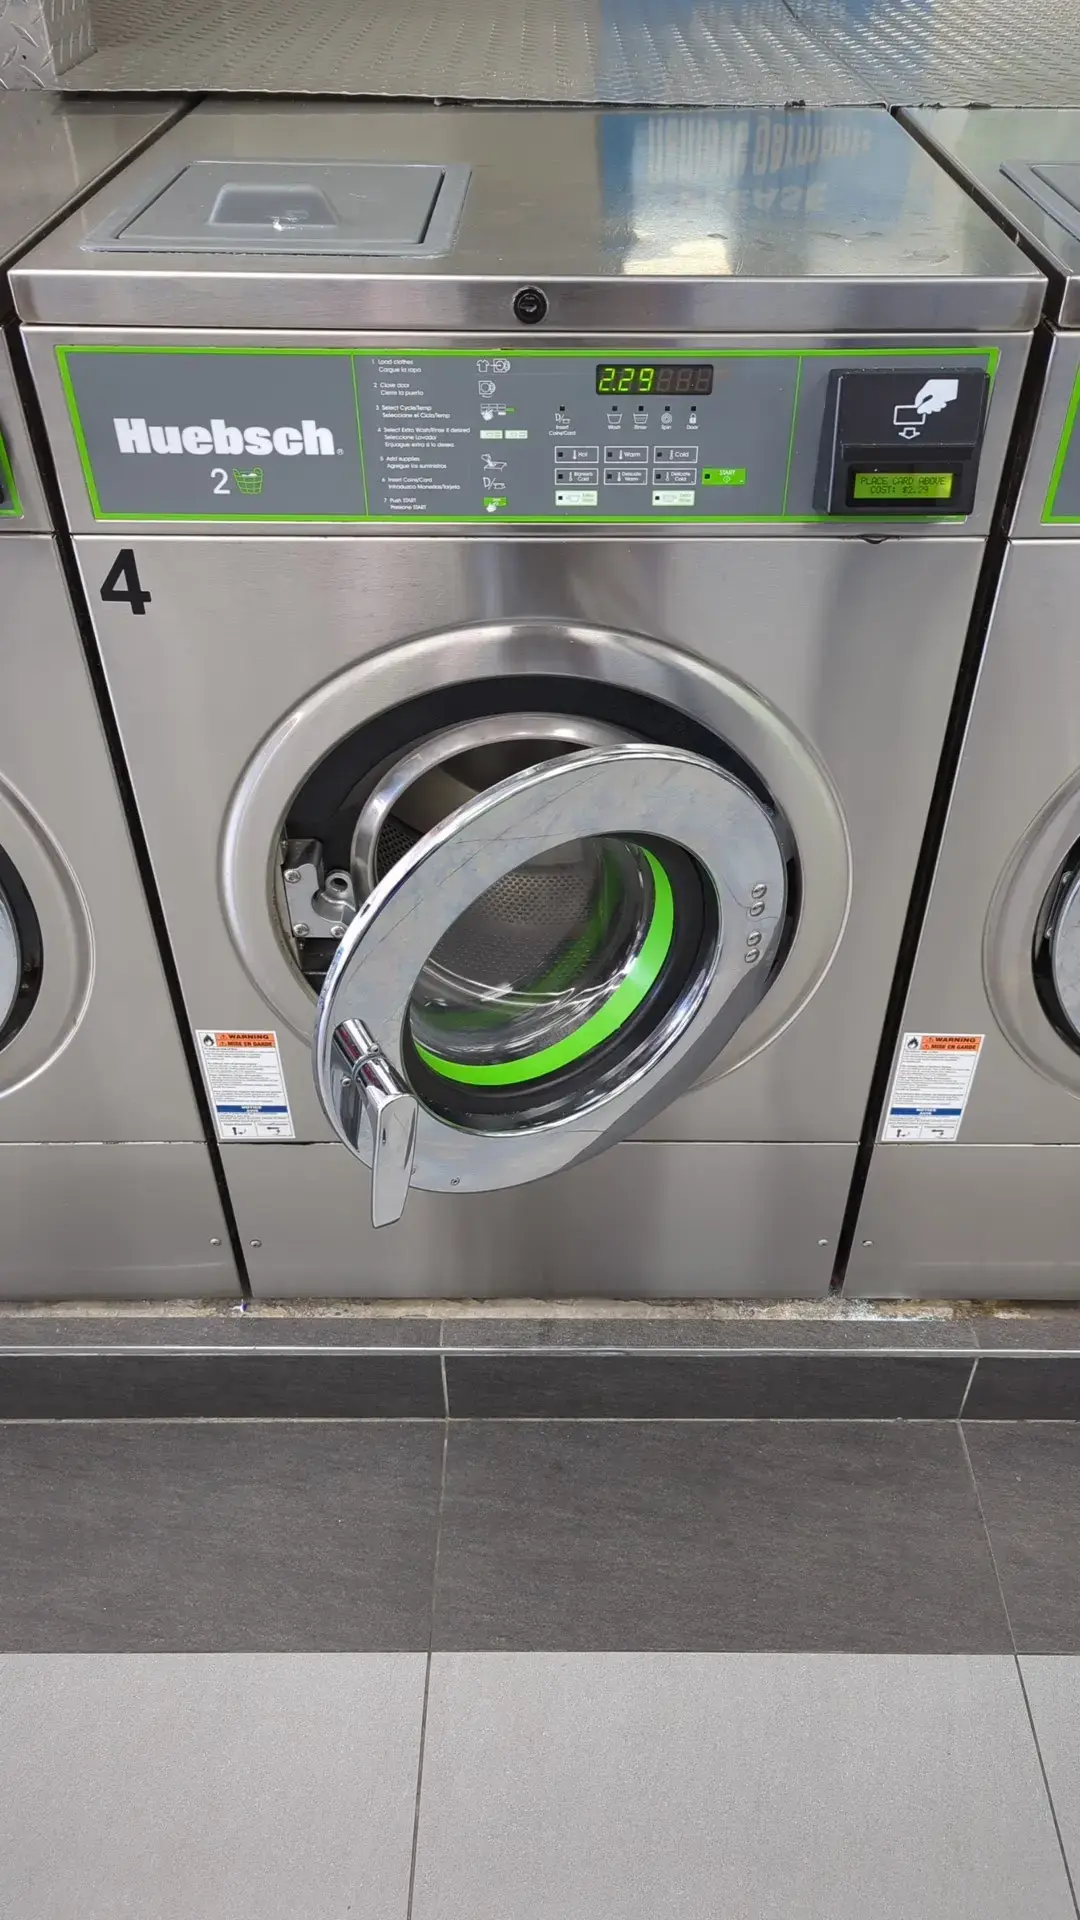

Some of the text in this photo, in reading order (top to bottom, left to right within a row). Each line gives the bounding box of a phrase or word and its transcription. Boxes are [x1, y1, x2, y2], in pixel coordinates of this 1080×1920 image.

[598, 367, 655, 392] 2.29
[210, 467, 231, 494] 2
[860, 476, 947, 485] PLACE CARD ABOVE
[870, 485, 929, 494] COST: $2.29
[100, 548, 152, 615] 4
